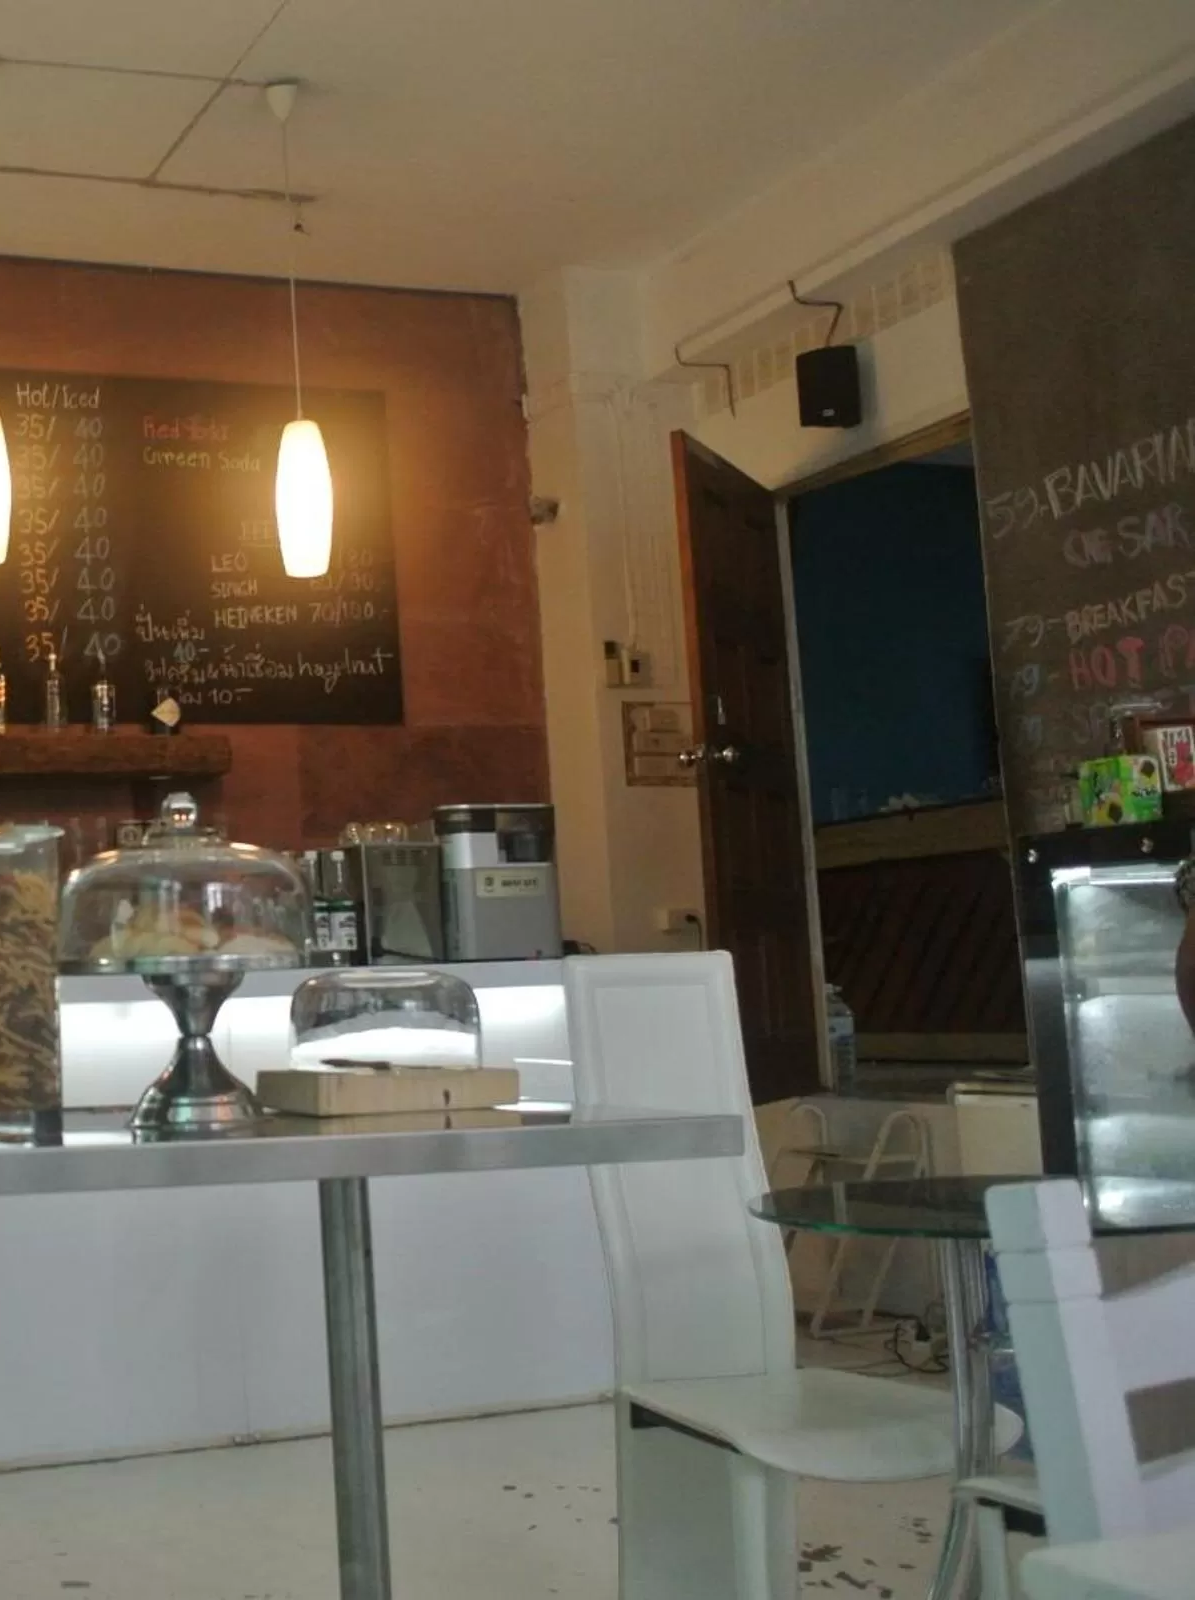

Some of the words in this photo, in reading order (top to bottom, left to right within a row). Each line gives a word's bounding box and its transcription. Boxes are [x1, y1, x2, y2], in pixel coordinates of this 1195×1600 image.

[1043, 417, 1195, 520] BAVARIA
[74, 506, 107, 533] 40
[74, 536, 110, 565] 40
[210, 551, 248, 573] LEO
[20, 567, 60, 594] 35/
[76, 566, 115, 595] 40
[76, 596, 115, 623] 40
[1064, 571, 1195, 644] BREAKFAS
[83, 630, 122, 660] 40
[1068, 636, 1146, 691] HOT
